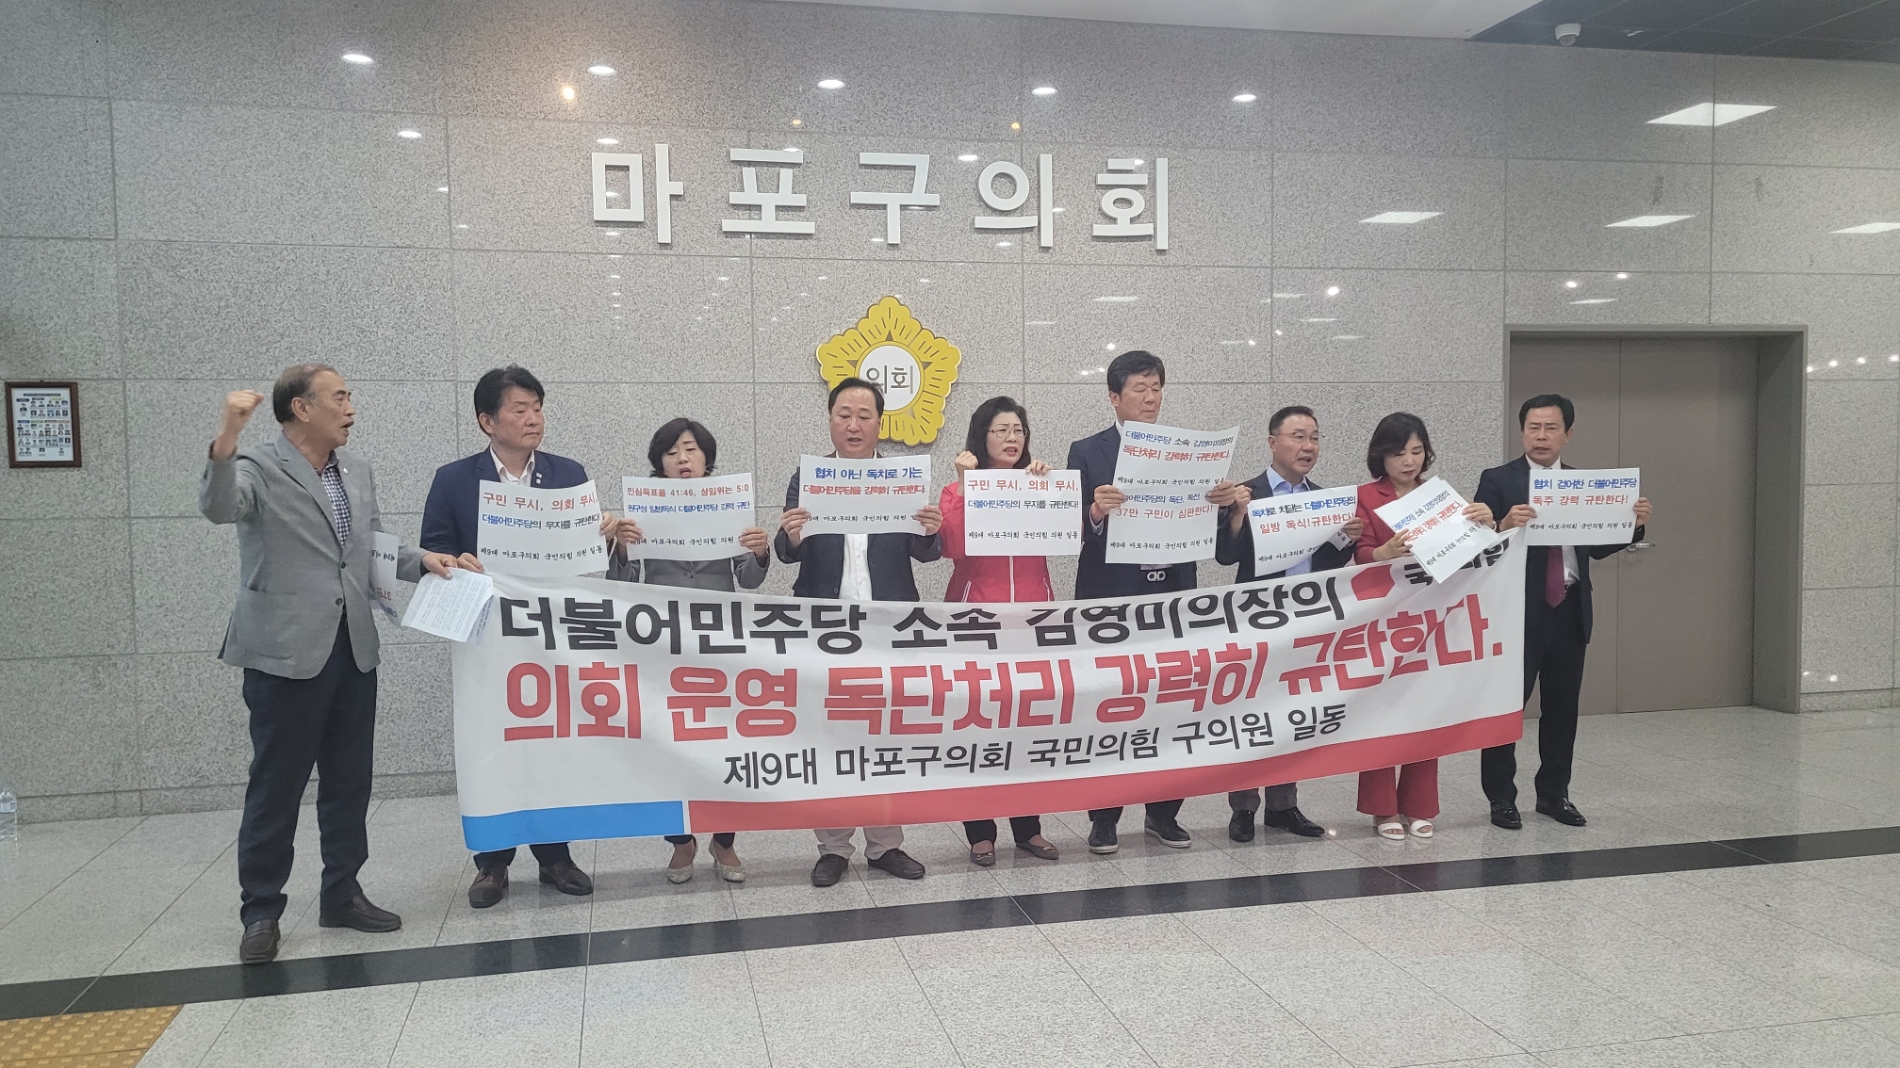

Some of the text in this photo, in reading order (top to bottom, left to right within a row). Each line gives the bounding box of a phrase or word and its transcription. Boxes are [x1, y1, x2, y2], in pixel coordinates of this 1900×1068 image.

[591, 143, 1169, 251] 마포구의회
[866, 365, 913, 394] 의회
[1126, 430, 1171, 445] 더불어민주당
[1174, 438, 1190, 447] 소속
[1123, 445, 1161, 460] 독단처리
[1165, 451, 1193, 461] 강력히
[815, 467, 923, 479] 협치 아닌 독치로 가는
[701, 486, 732, 496] 상임위는
[737, 484, 749, 492] 5:0
[803, 485, 861, 495] 더불어민주당을
[865, 486, 889, 495] 강력히
[968, 480, 1078, 491] 구민 무시, 의회 무시,
[1534, 479, 1552, 489] 협치
[1588, 478, 1637, 489] 더불어민주당
[483, 492, 507, 506] 구민
[514, 497, 543, 511] 무시,
[551, 498, 574, 511] 의회
[678, 504, 718, 512] 더불어민주당
[721, 502, 734, 511] 강력
[737, 501, 750, 509] 규탄
[968, 500, 1078, 509] 더불어민주당의 무지를 규탄한다!
[1252, 496, 1356, 518] 독치로 치닫는 더불어민주당의
[1533, 495, 1628, 506] 독주 강력 규탄한다!
[1117, 505, 1213, 519] 37만 구민이 심판한다!
[482, 514, 541, 529] 더불어민주당의
[545, 520, 571, 529] 무지를
[1260, 522, 1280, 534] 일방
[969, 531, 983, 539] 제9대
[988, 531, 1019, 539] 마포구의회
[1023, 531, 1047, 539] 국민의힘
[1066, 531, 1077, 539] 일동
[1203, 537, 1213, 545] 일동
[481, 545, 603, 560] 제9대 마포구의회 국민의힘 의원 일동
[1276, 549, 1304, 559] 마포구의회
[500, 596, 866, 655] 더불어민주당
[891, 607, 1001, 649] 소속
[1026, 577, 1344, 647] 김영미의장의
[504, 593, 1503, 742] 의회 운영 독단처리 강력히 규탄한다.
[723, 703, 1347, 790] 제9대 마포구의회 국민의힘 구의원 일동
